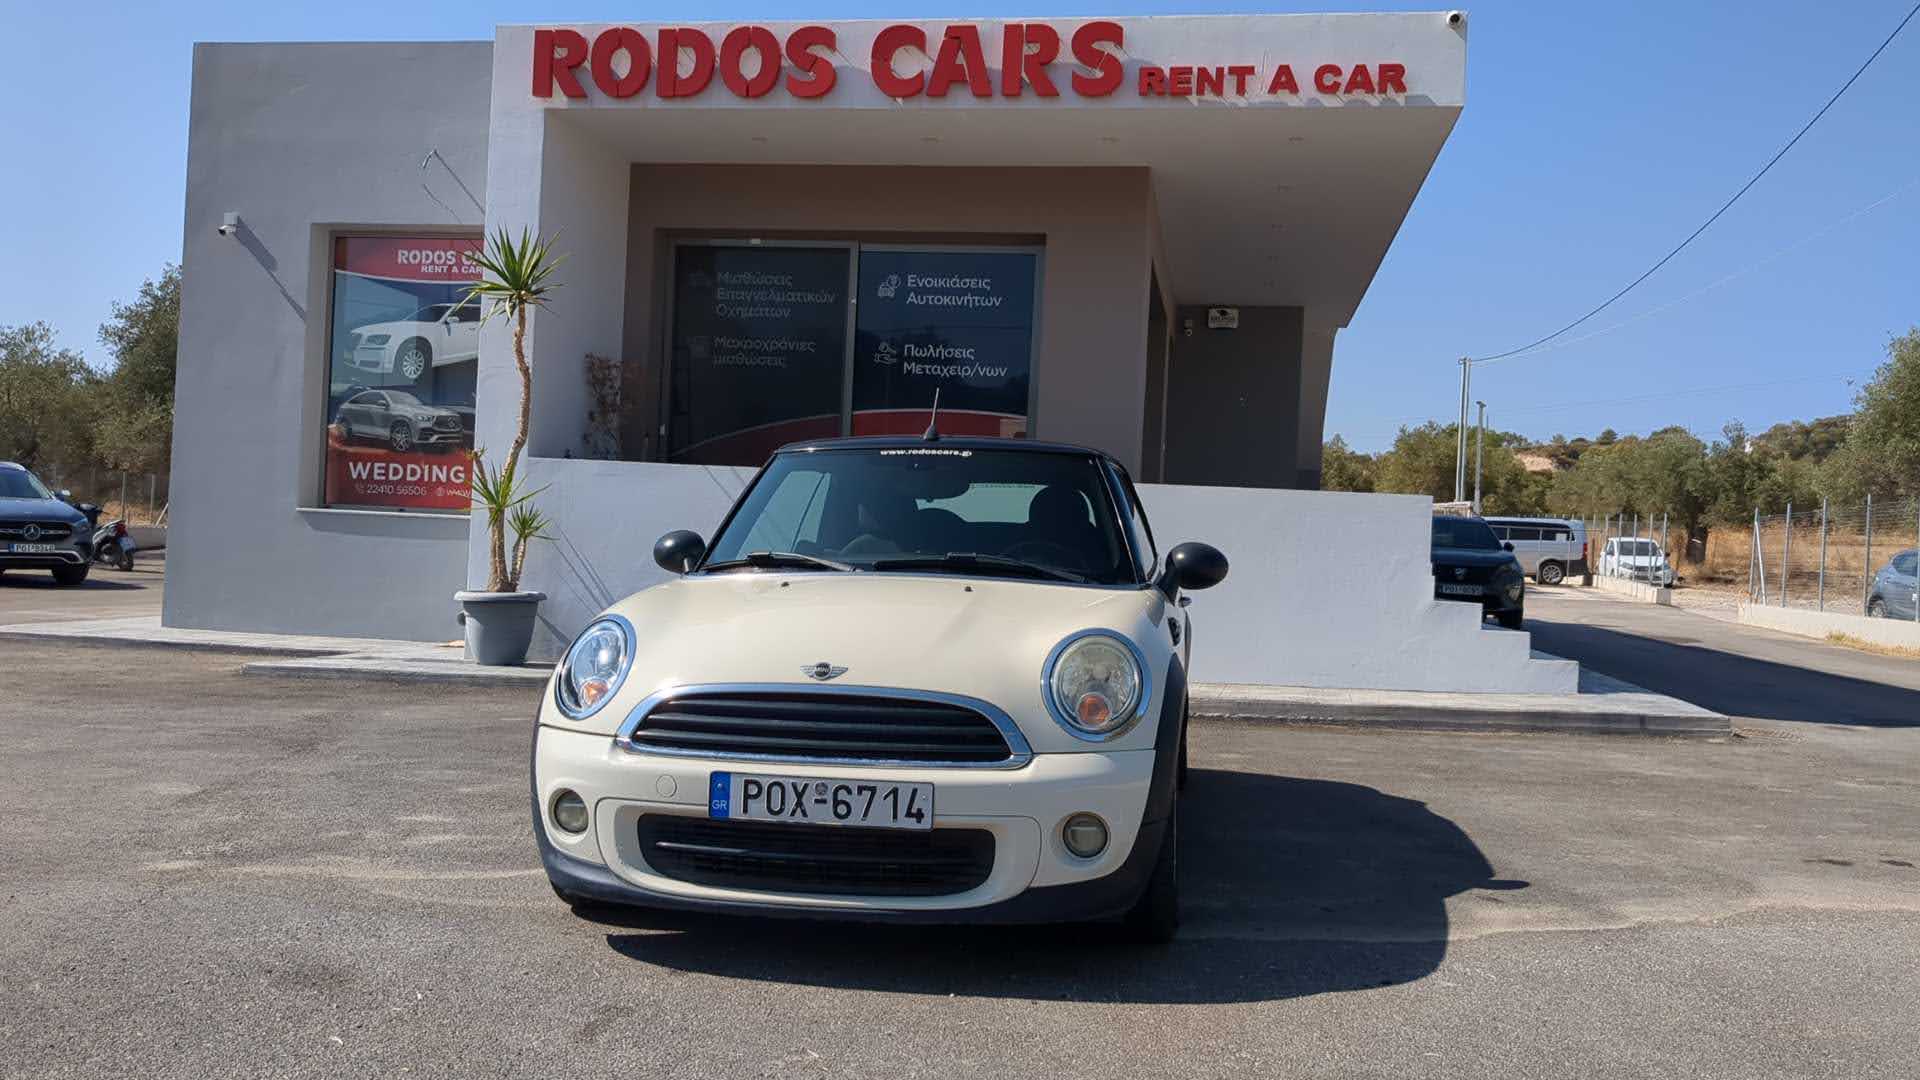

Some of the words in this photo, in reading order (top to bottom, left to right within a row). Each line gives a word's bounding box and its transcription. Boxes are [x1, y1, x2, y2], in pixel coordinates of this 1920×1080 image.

[532, 26, 837, 98] RODOS
[870, 20, 1124, 97] CARS
[1138, 66, 1256, 96] RENT
[1267, 64, 1300, 95] A
[1314, 63, 1408, 95] CAR
[397, 249, 457, 266] RODOS
[421, 265, 449, 274] RENT
[451, 265, 460, 274] A
[907, 273, 992, 291] Ενοικιάσεις
[906, 291, 1003, 309] Αυτοκινήτων
[903, 343, 976, 360] Πωλήσεις
[903, 361, 1008, 378] Μεταχειρ/νων
[349, 461, 465, 484] WEDDING
[711, 800, 728, 810] GR
[741, 778, 925, 824] POX-6714
